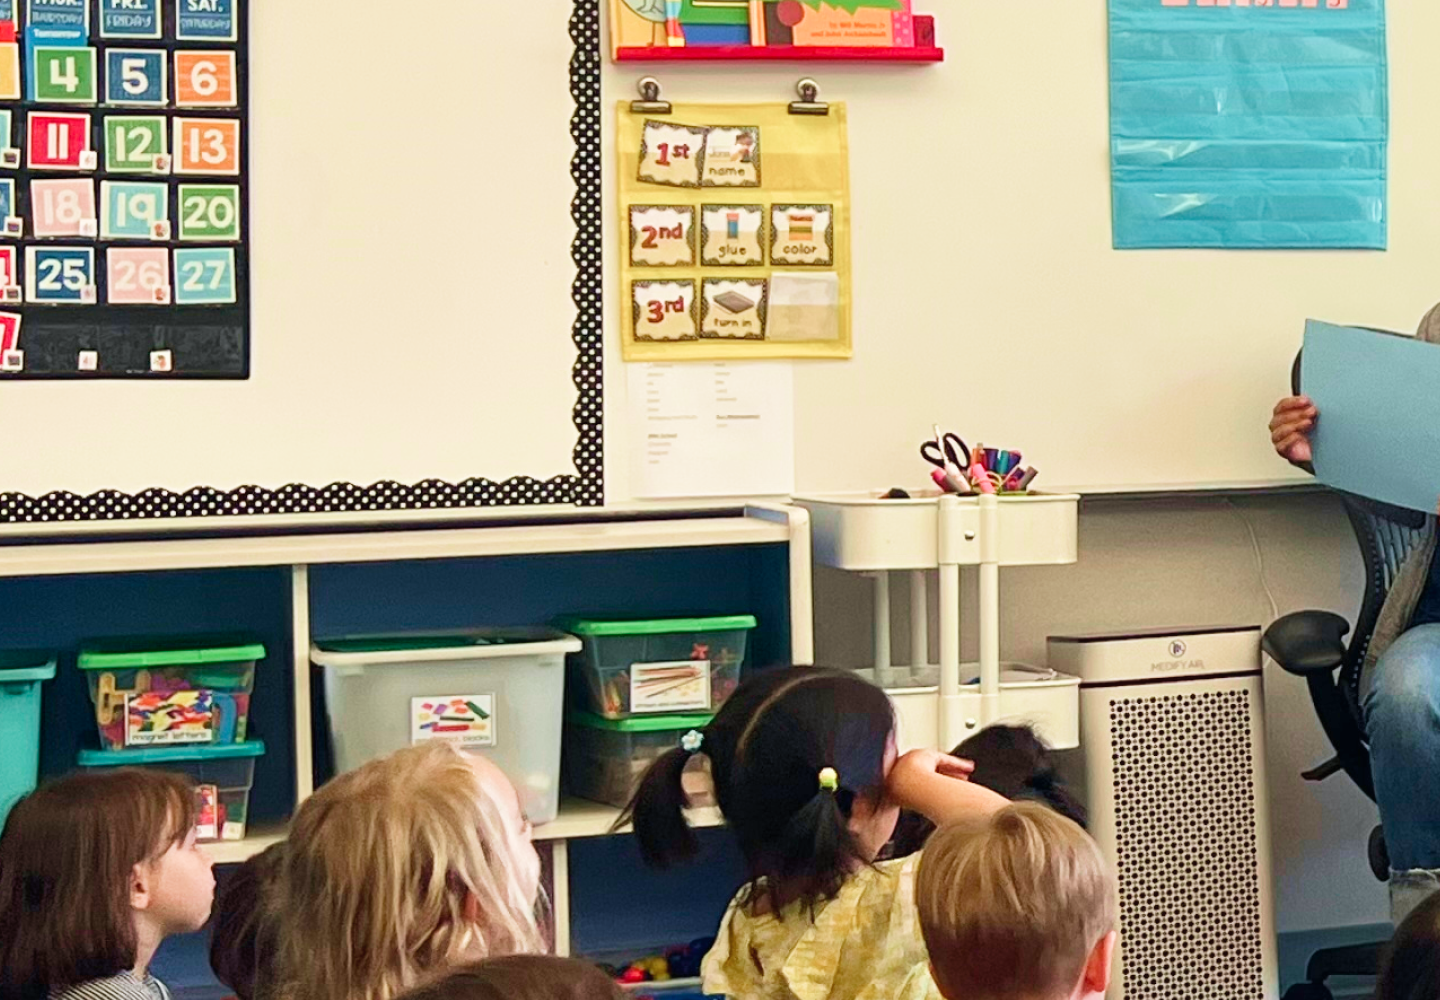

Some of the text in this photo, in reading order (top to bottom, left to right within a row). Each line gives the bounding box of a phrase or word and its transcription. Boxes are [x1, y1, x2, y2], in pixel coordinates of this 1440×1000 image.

[106, 14, 151, 27] FRIDAY
[50, 56, 79, 92] 4
[122, 59, 149, 95] 5
[191, 61, 218, 95] 6
[47, 123, 69, 159] 11
[116, 127, 154, 163] 12
[190, 128, 227, 164] 13
[655, 143, 690, 167] 1st
[709, 167, 746, 177] name
[44, 189, 81, 225] 18
[117, 192, 157, 228] 19
[184, 195, 234, 229] 20
[641, 222, 683, 249] 2nd
[718, 244, 747, 258] glue
[783, 243, 818, 255] color
[39, 259, 87, 291] 25
[114, 260, 163, 291] 26
[182, 260, 226, 291] 27
[647, 296, 684, 324] 3rd
[714, 318, 752, 327] turn in
[132, 731, 207, 744] magnet letters
